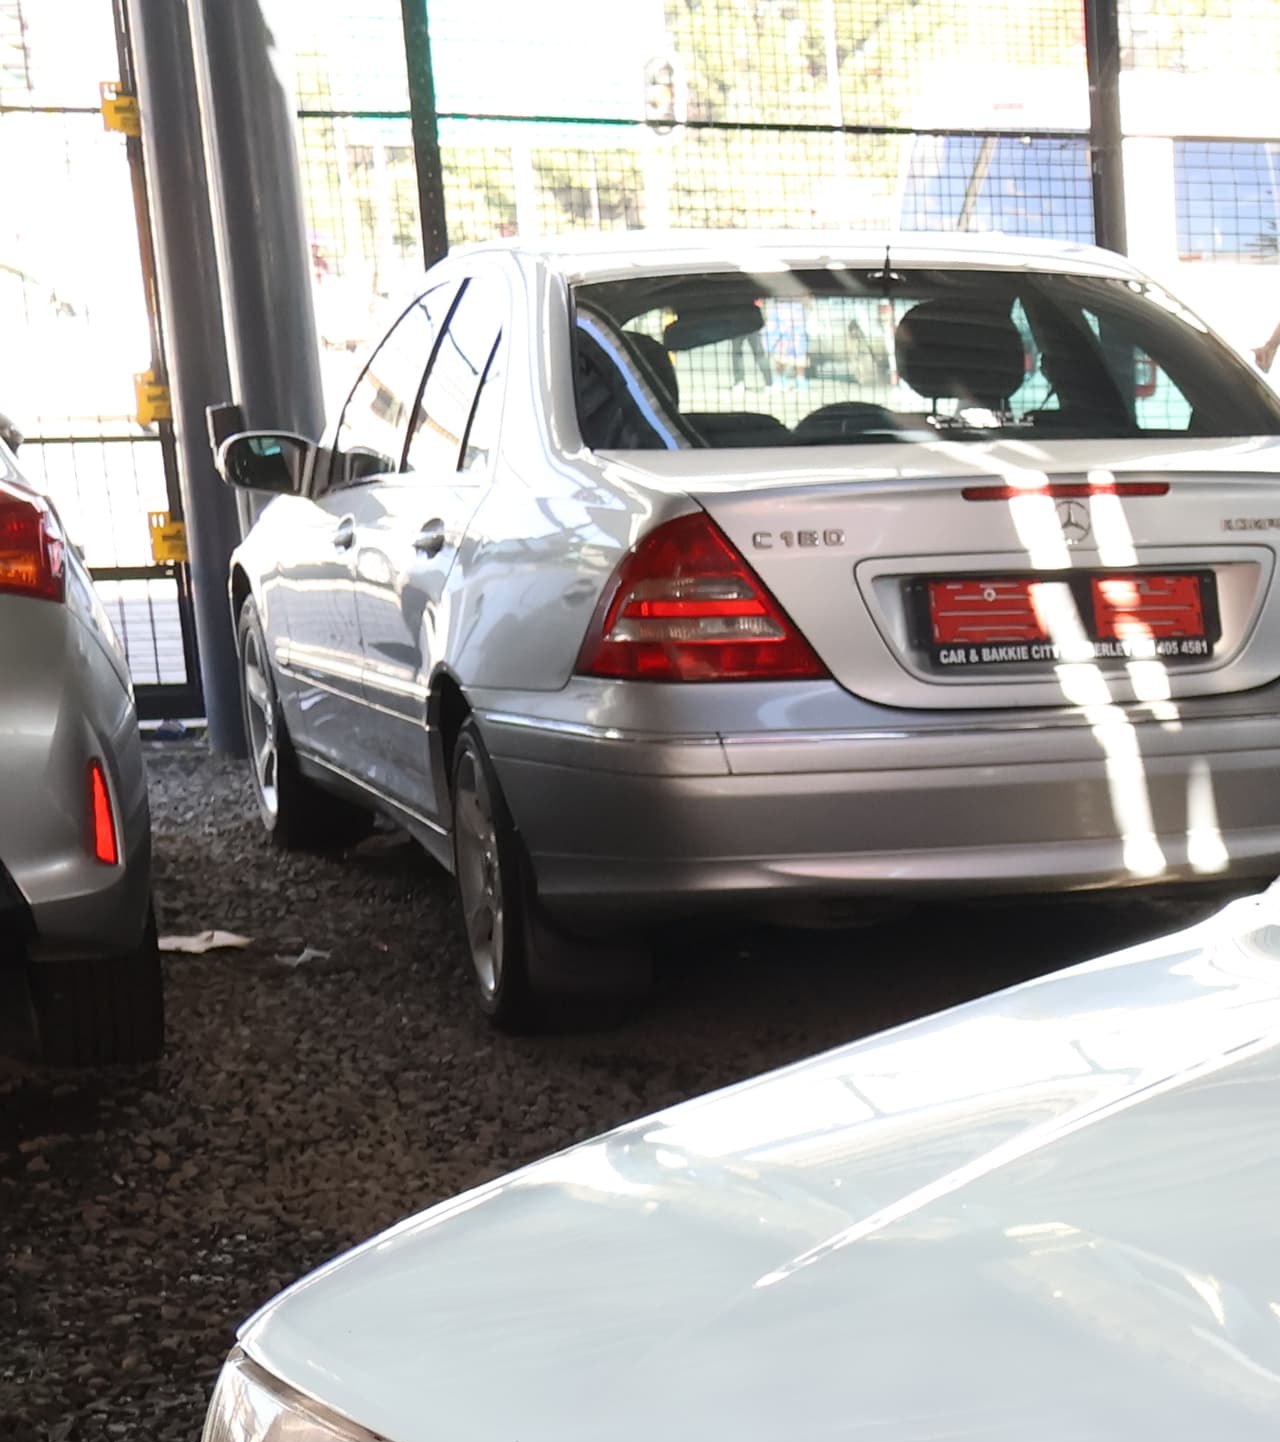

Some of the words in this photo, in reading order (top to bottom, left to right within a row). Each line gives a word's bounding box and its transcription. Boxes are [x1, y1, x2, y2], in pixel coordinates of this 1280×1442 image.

[940, 648, 967, 664] CAR
[969, 647, 980, 663] &
[982, 644, 1029, 662] BAKKIE
[1181, 638, 1208, 655] 4581
